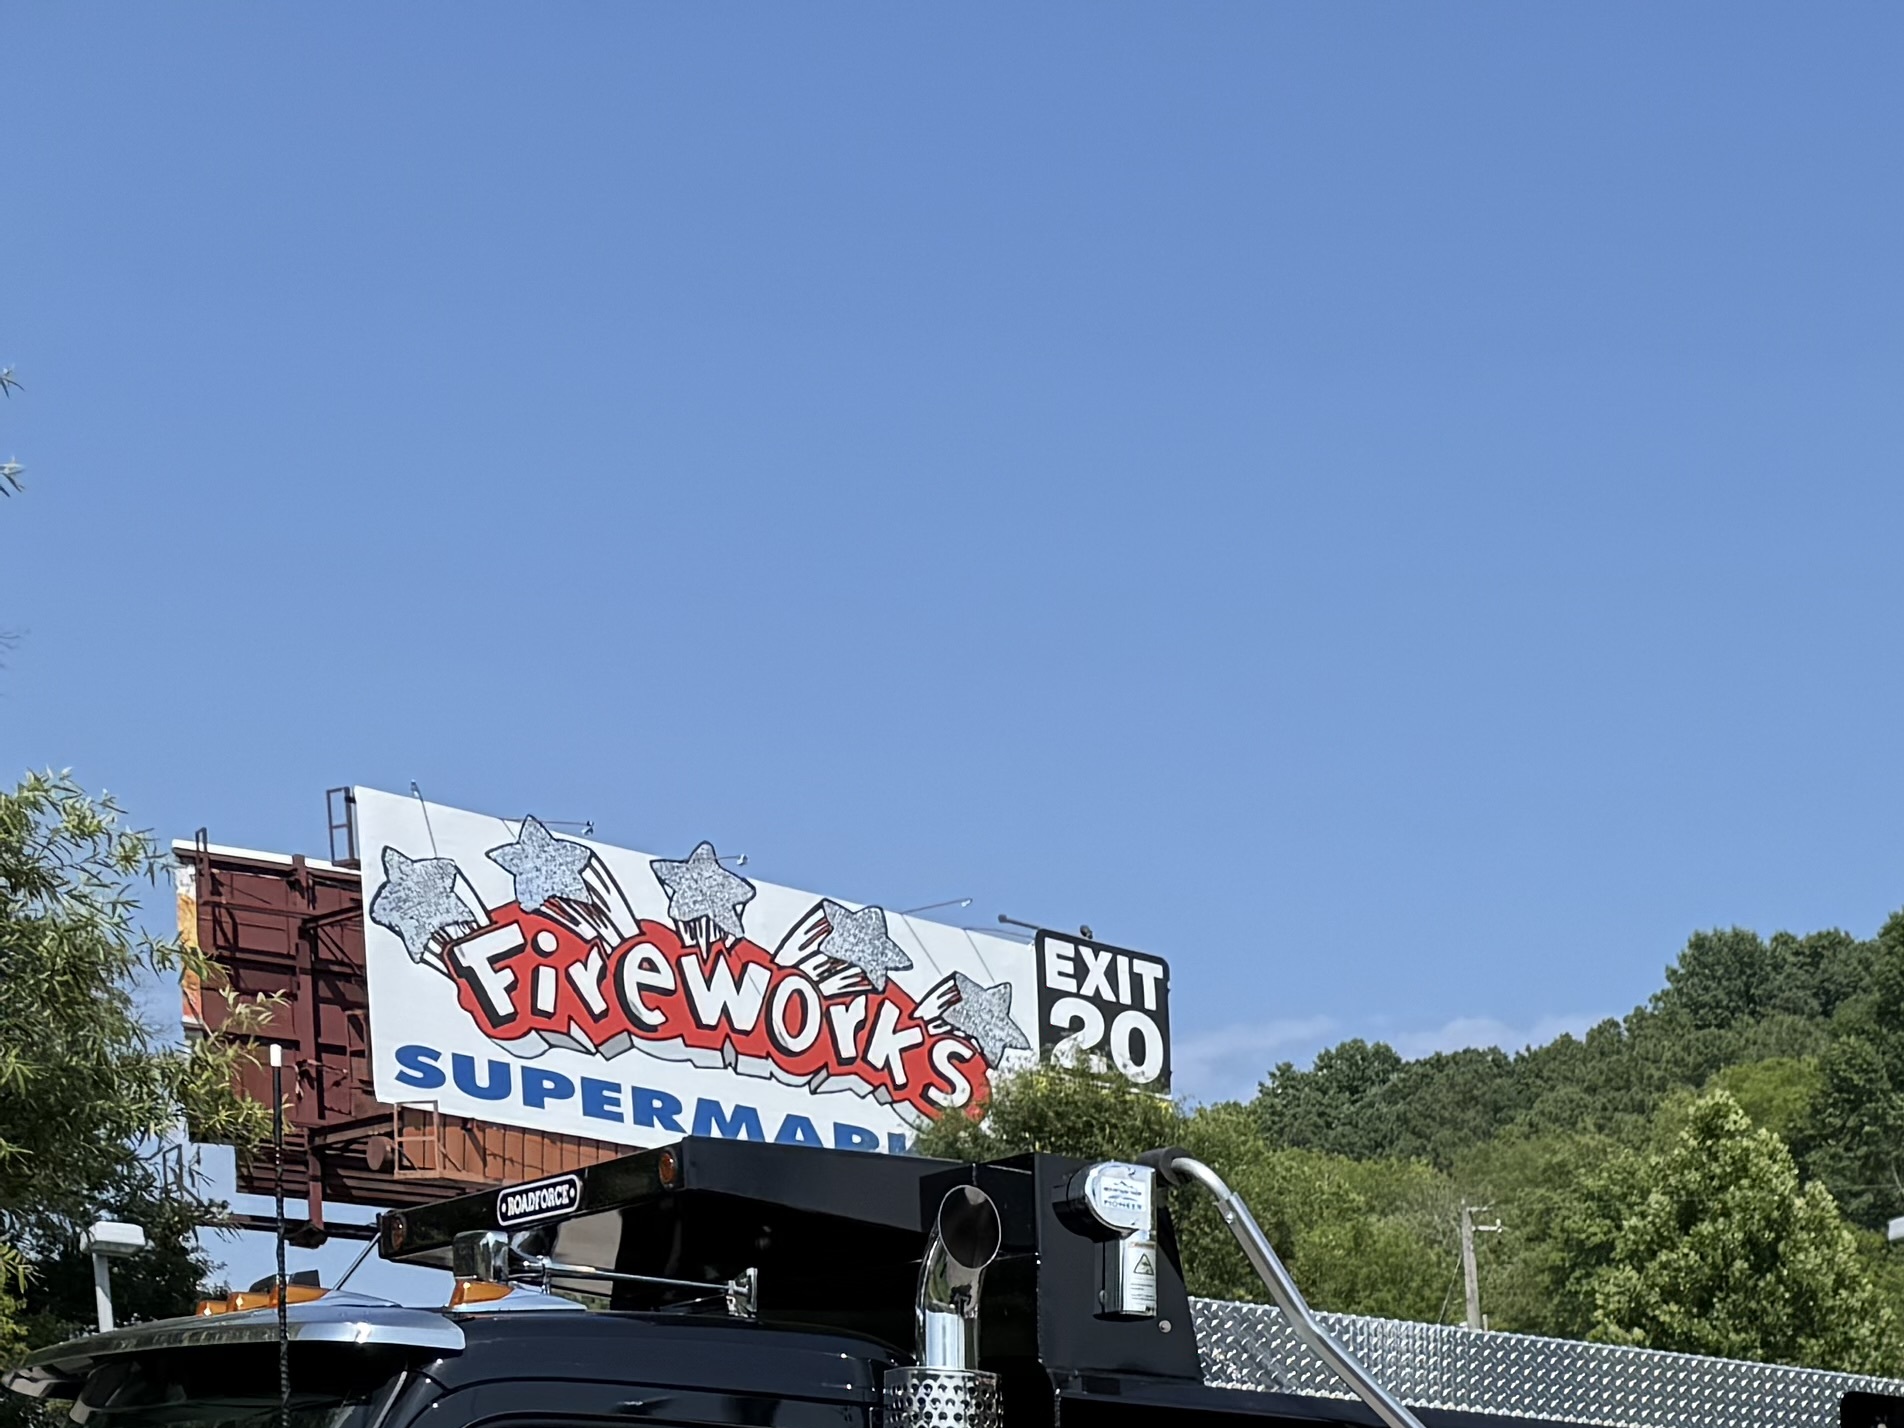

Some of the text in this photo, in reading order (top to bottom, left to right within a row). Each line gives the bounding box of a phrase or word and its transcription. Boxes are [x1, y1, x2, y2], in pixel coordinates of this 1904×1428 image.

[1044, 937, 1163, 1010] EXIT
[458, 920, 976, 1108] Fireworks
[1049, 997, 1163, 1084] 20
[507, 1184, 569, 1216] ROADFORCE
